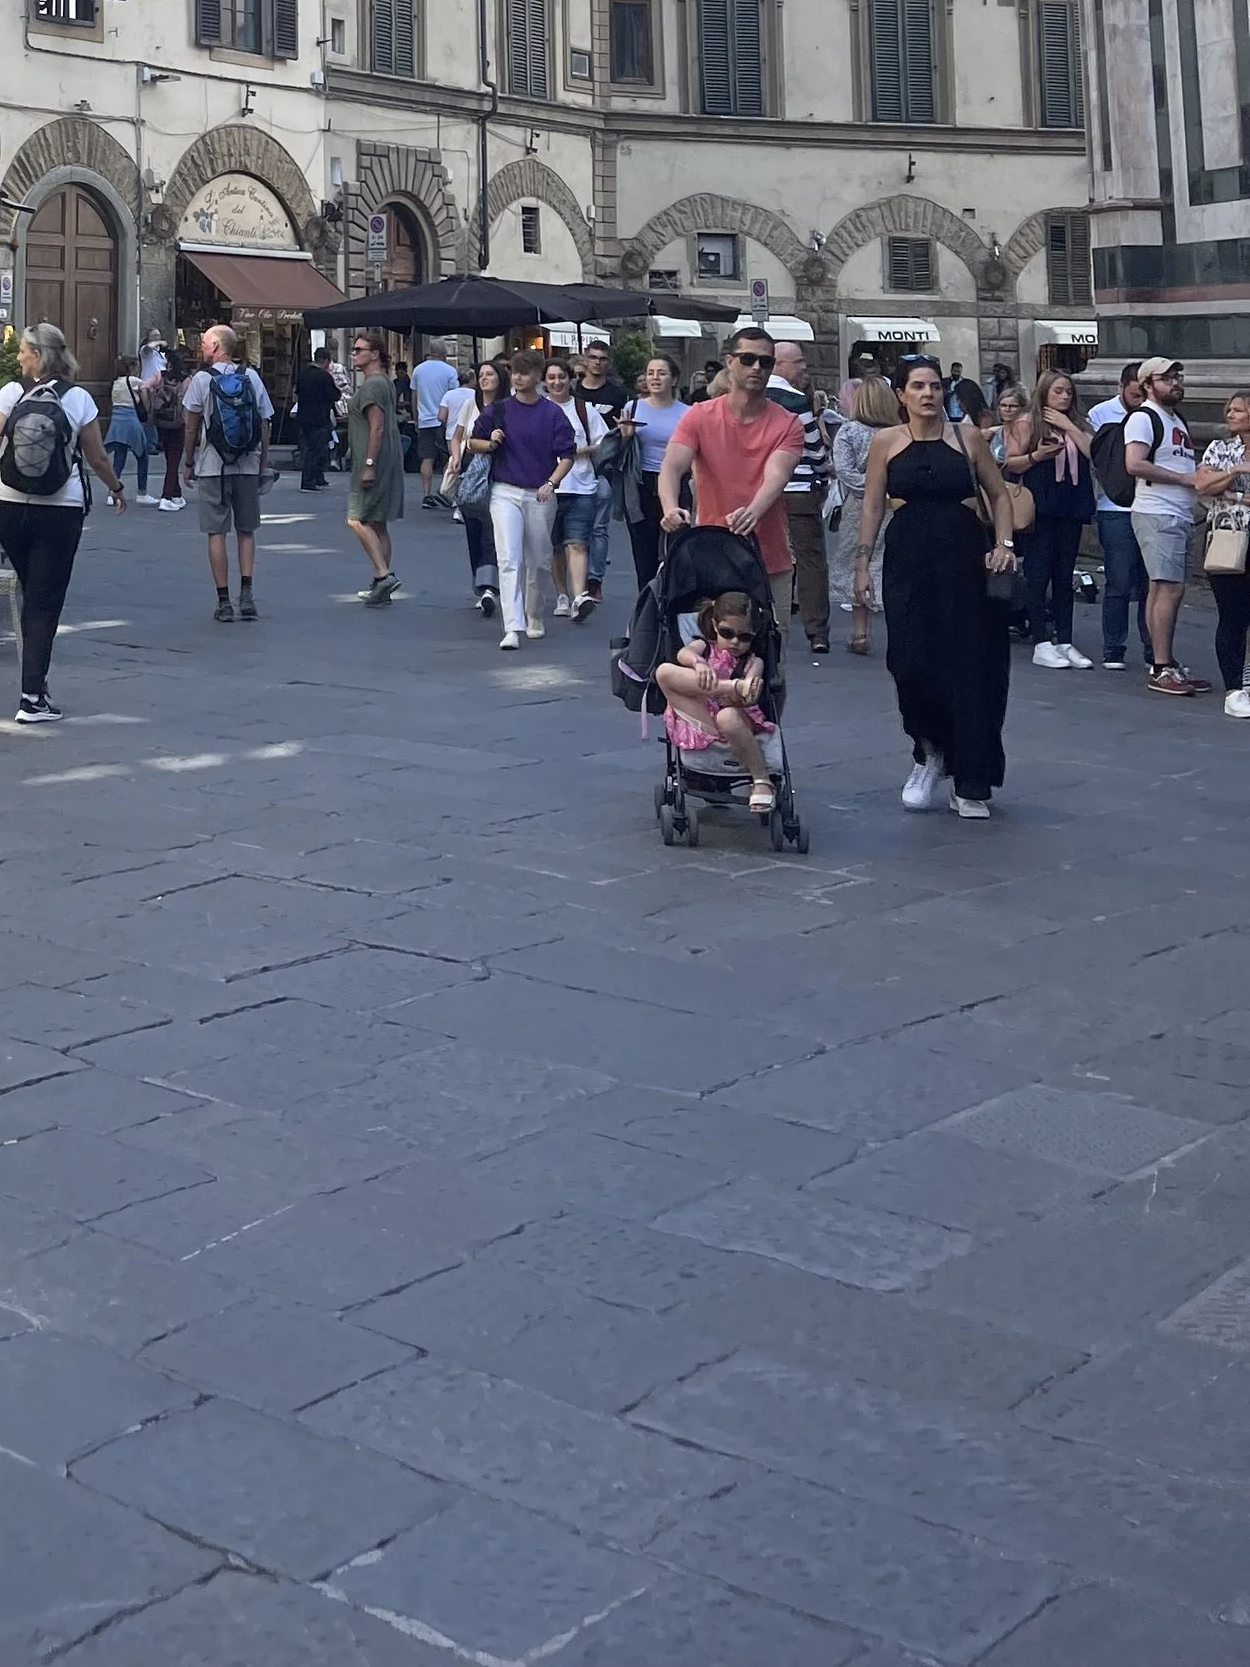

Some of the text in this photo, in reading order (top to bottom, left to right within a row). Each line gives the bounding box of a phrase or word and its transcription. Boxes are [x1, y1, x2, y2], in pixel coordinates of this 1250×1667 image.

[231, 203, 247, 215] del
[221, 217, 258, 239] Chianti
[560, 333, 568, 346] IL
[877, 330, 930, 341] MONTI
